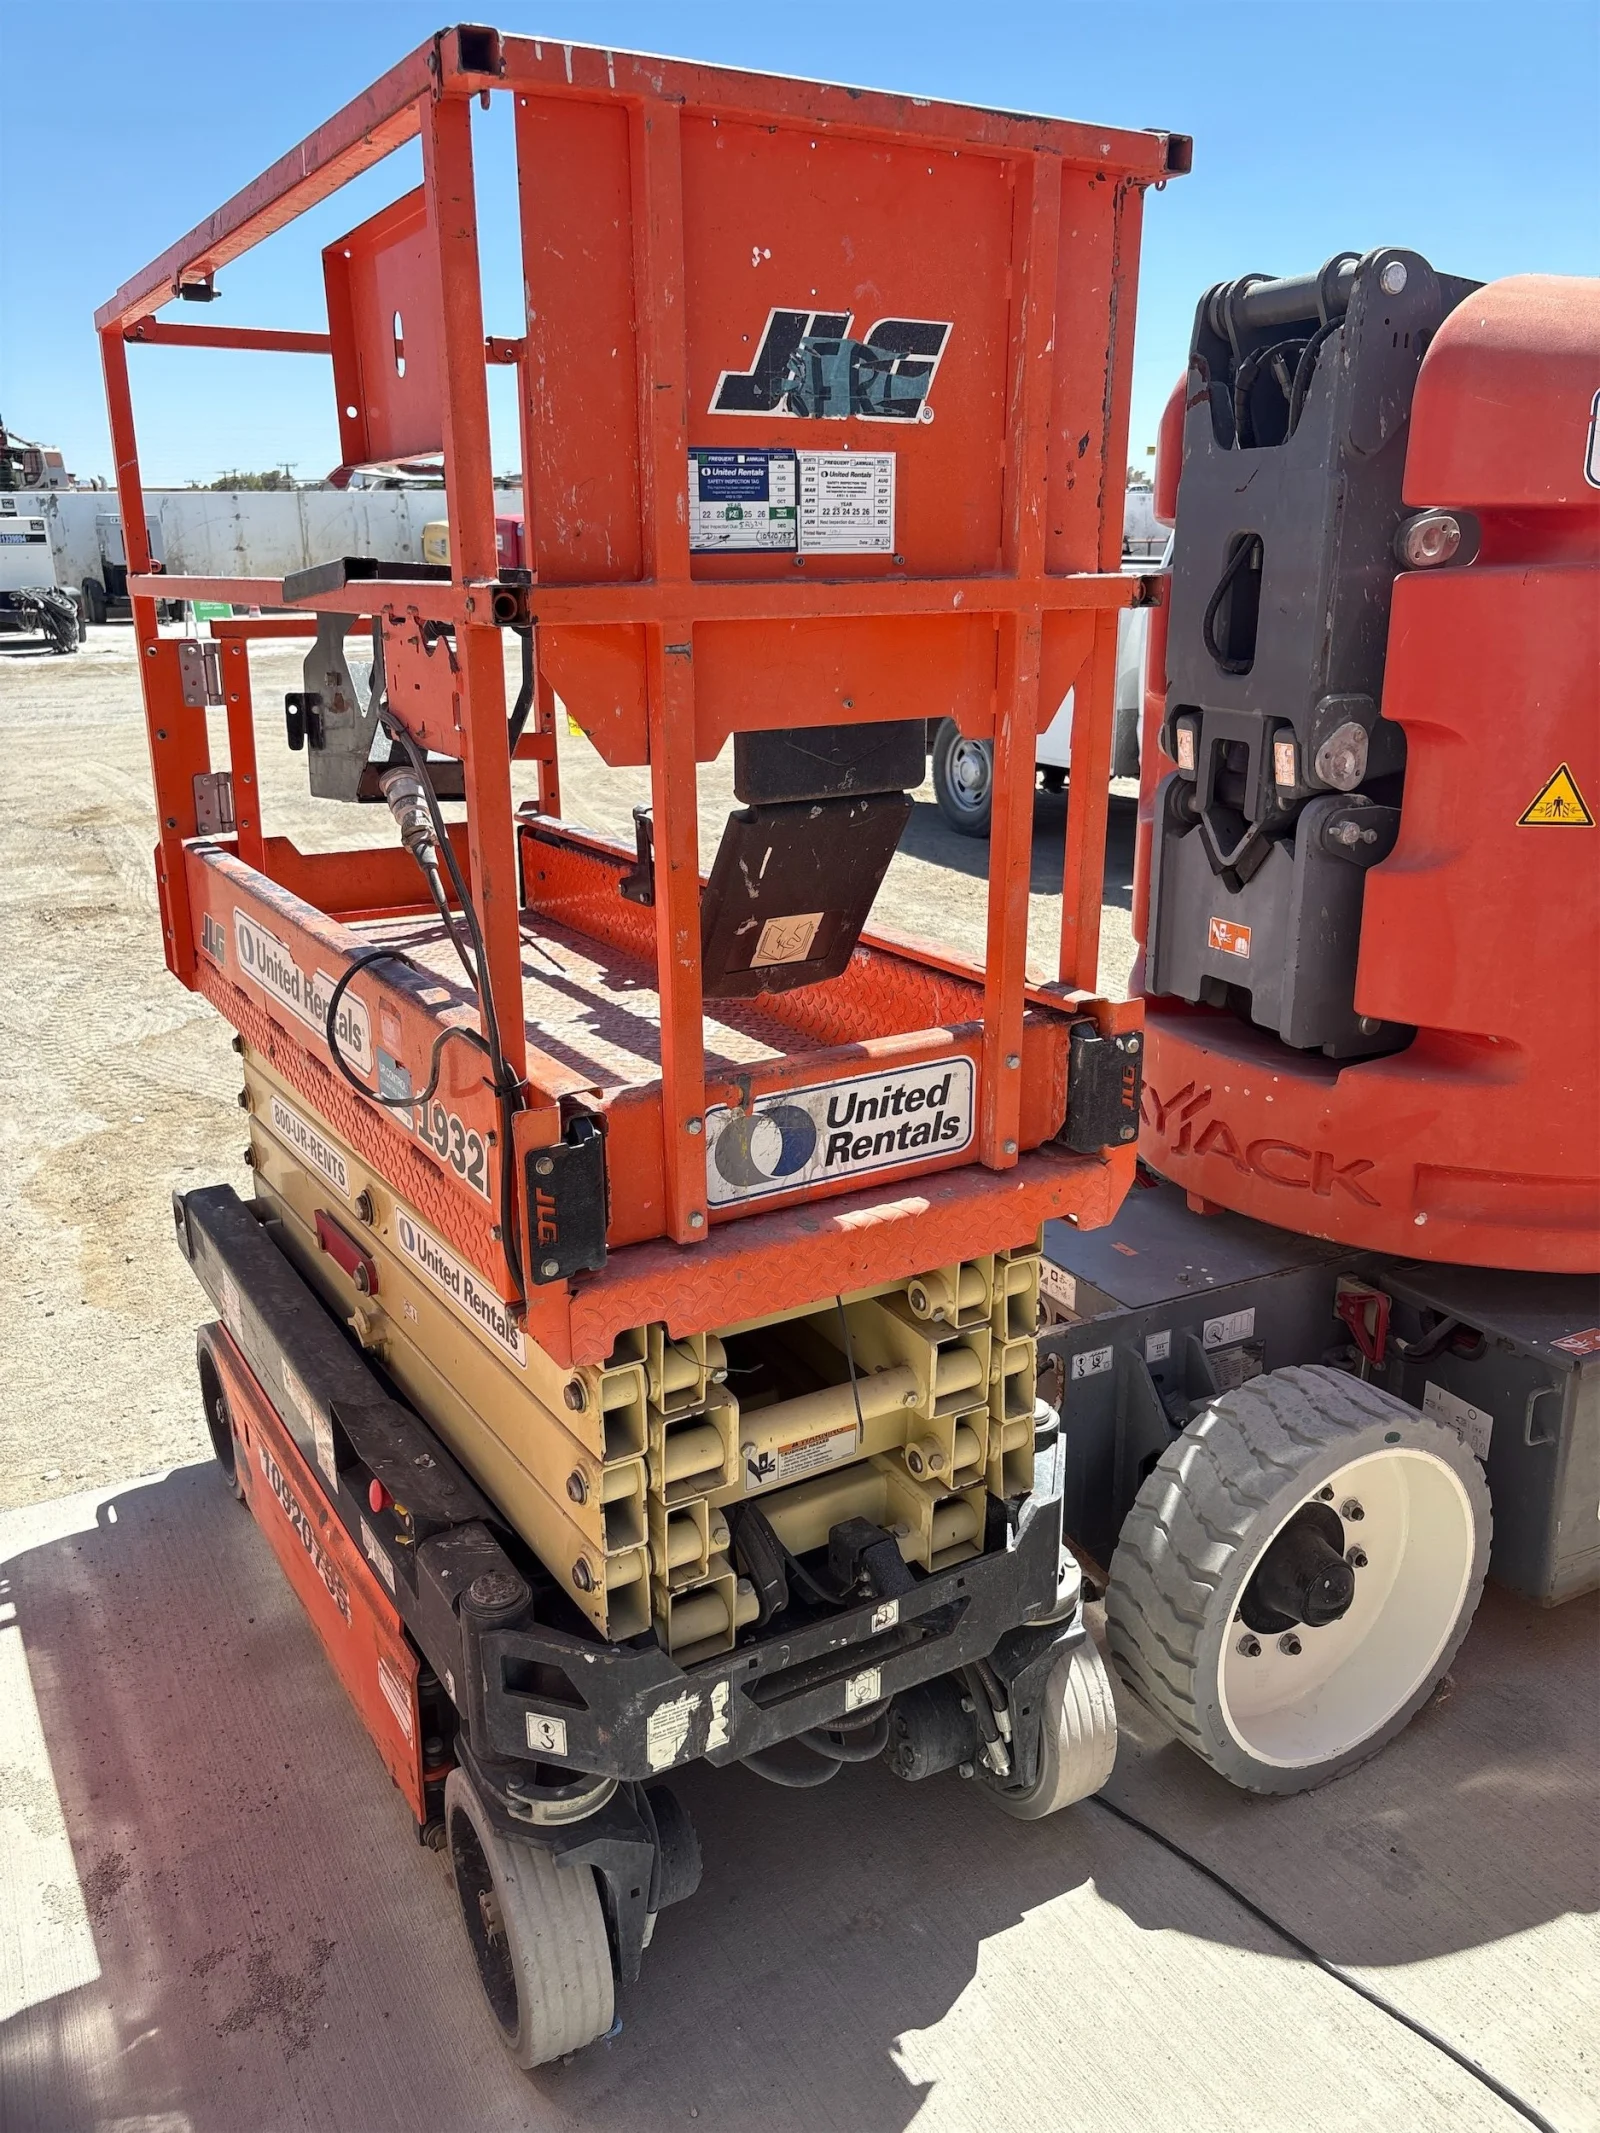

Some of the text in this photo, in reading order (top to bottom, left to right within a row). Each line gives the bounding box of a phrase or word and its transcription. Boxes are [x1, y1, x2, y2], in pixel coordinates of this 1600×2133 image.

[712, 468, 736, 476] United
[201, 912, 225, 964] JLG
[256, 937, 300, 1003] United
[826, 1072, 952, 1129] United
[1121, 1064, 1137, 1111] JLG
[274, 1104, 346, 1187] 800-UR-RENTS
[824, 1110, 961, 1168] Rentals
[535, 1187, 558, 1248] JLG
[417, 1233, 518, 1350] United Rentals
[808, 1438, 830, 1449] HAZARD
